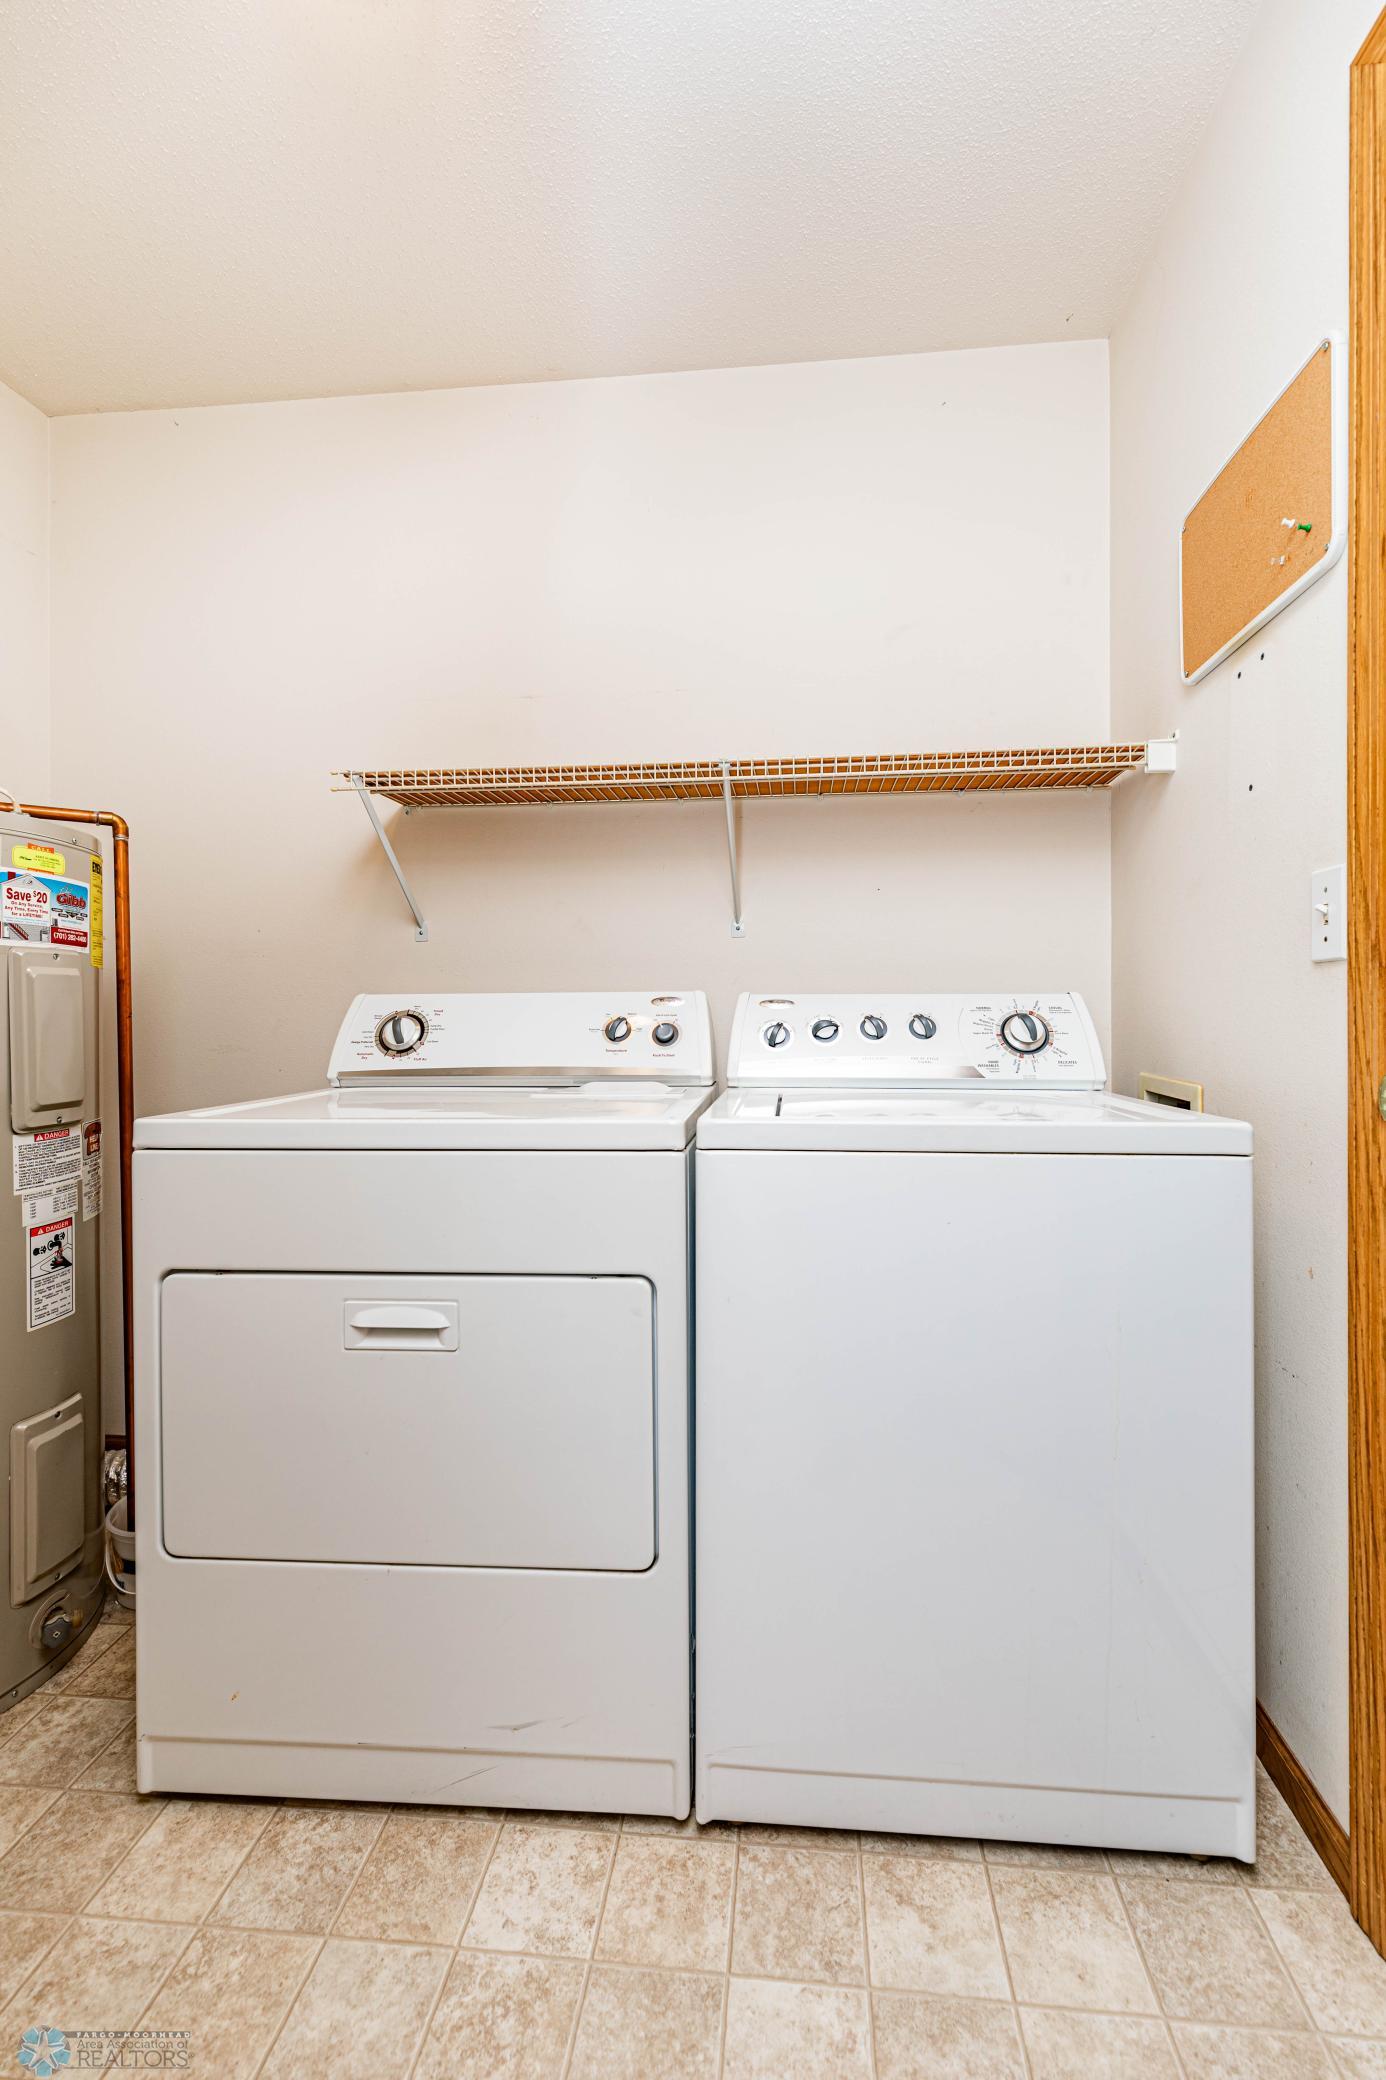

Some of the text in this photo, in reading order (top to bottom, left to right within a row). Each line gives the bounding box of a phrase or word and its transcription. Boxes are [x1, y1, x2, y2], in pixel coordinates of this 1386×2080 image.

[6, 887, 48, 904] Save $20
[44, 1129, 69, 1139] DANGER
[45, 1220, 69, 1233] DANGER
